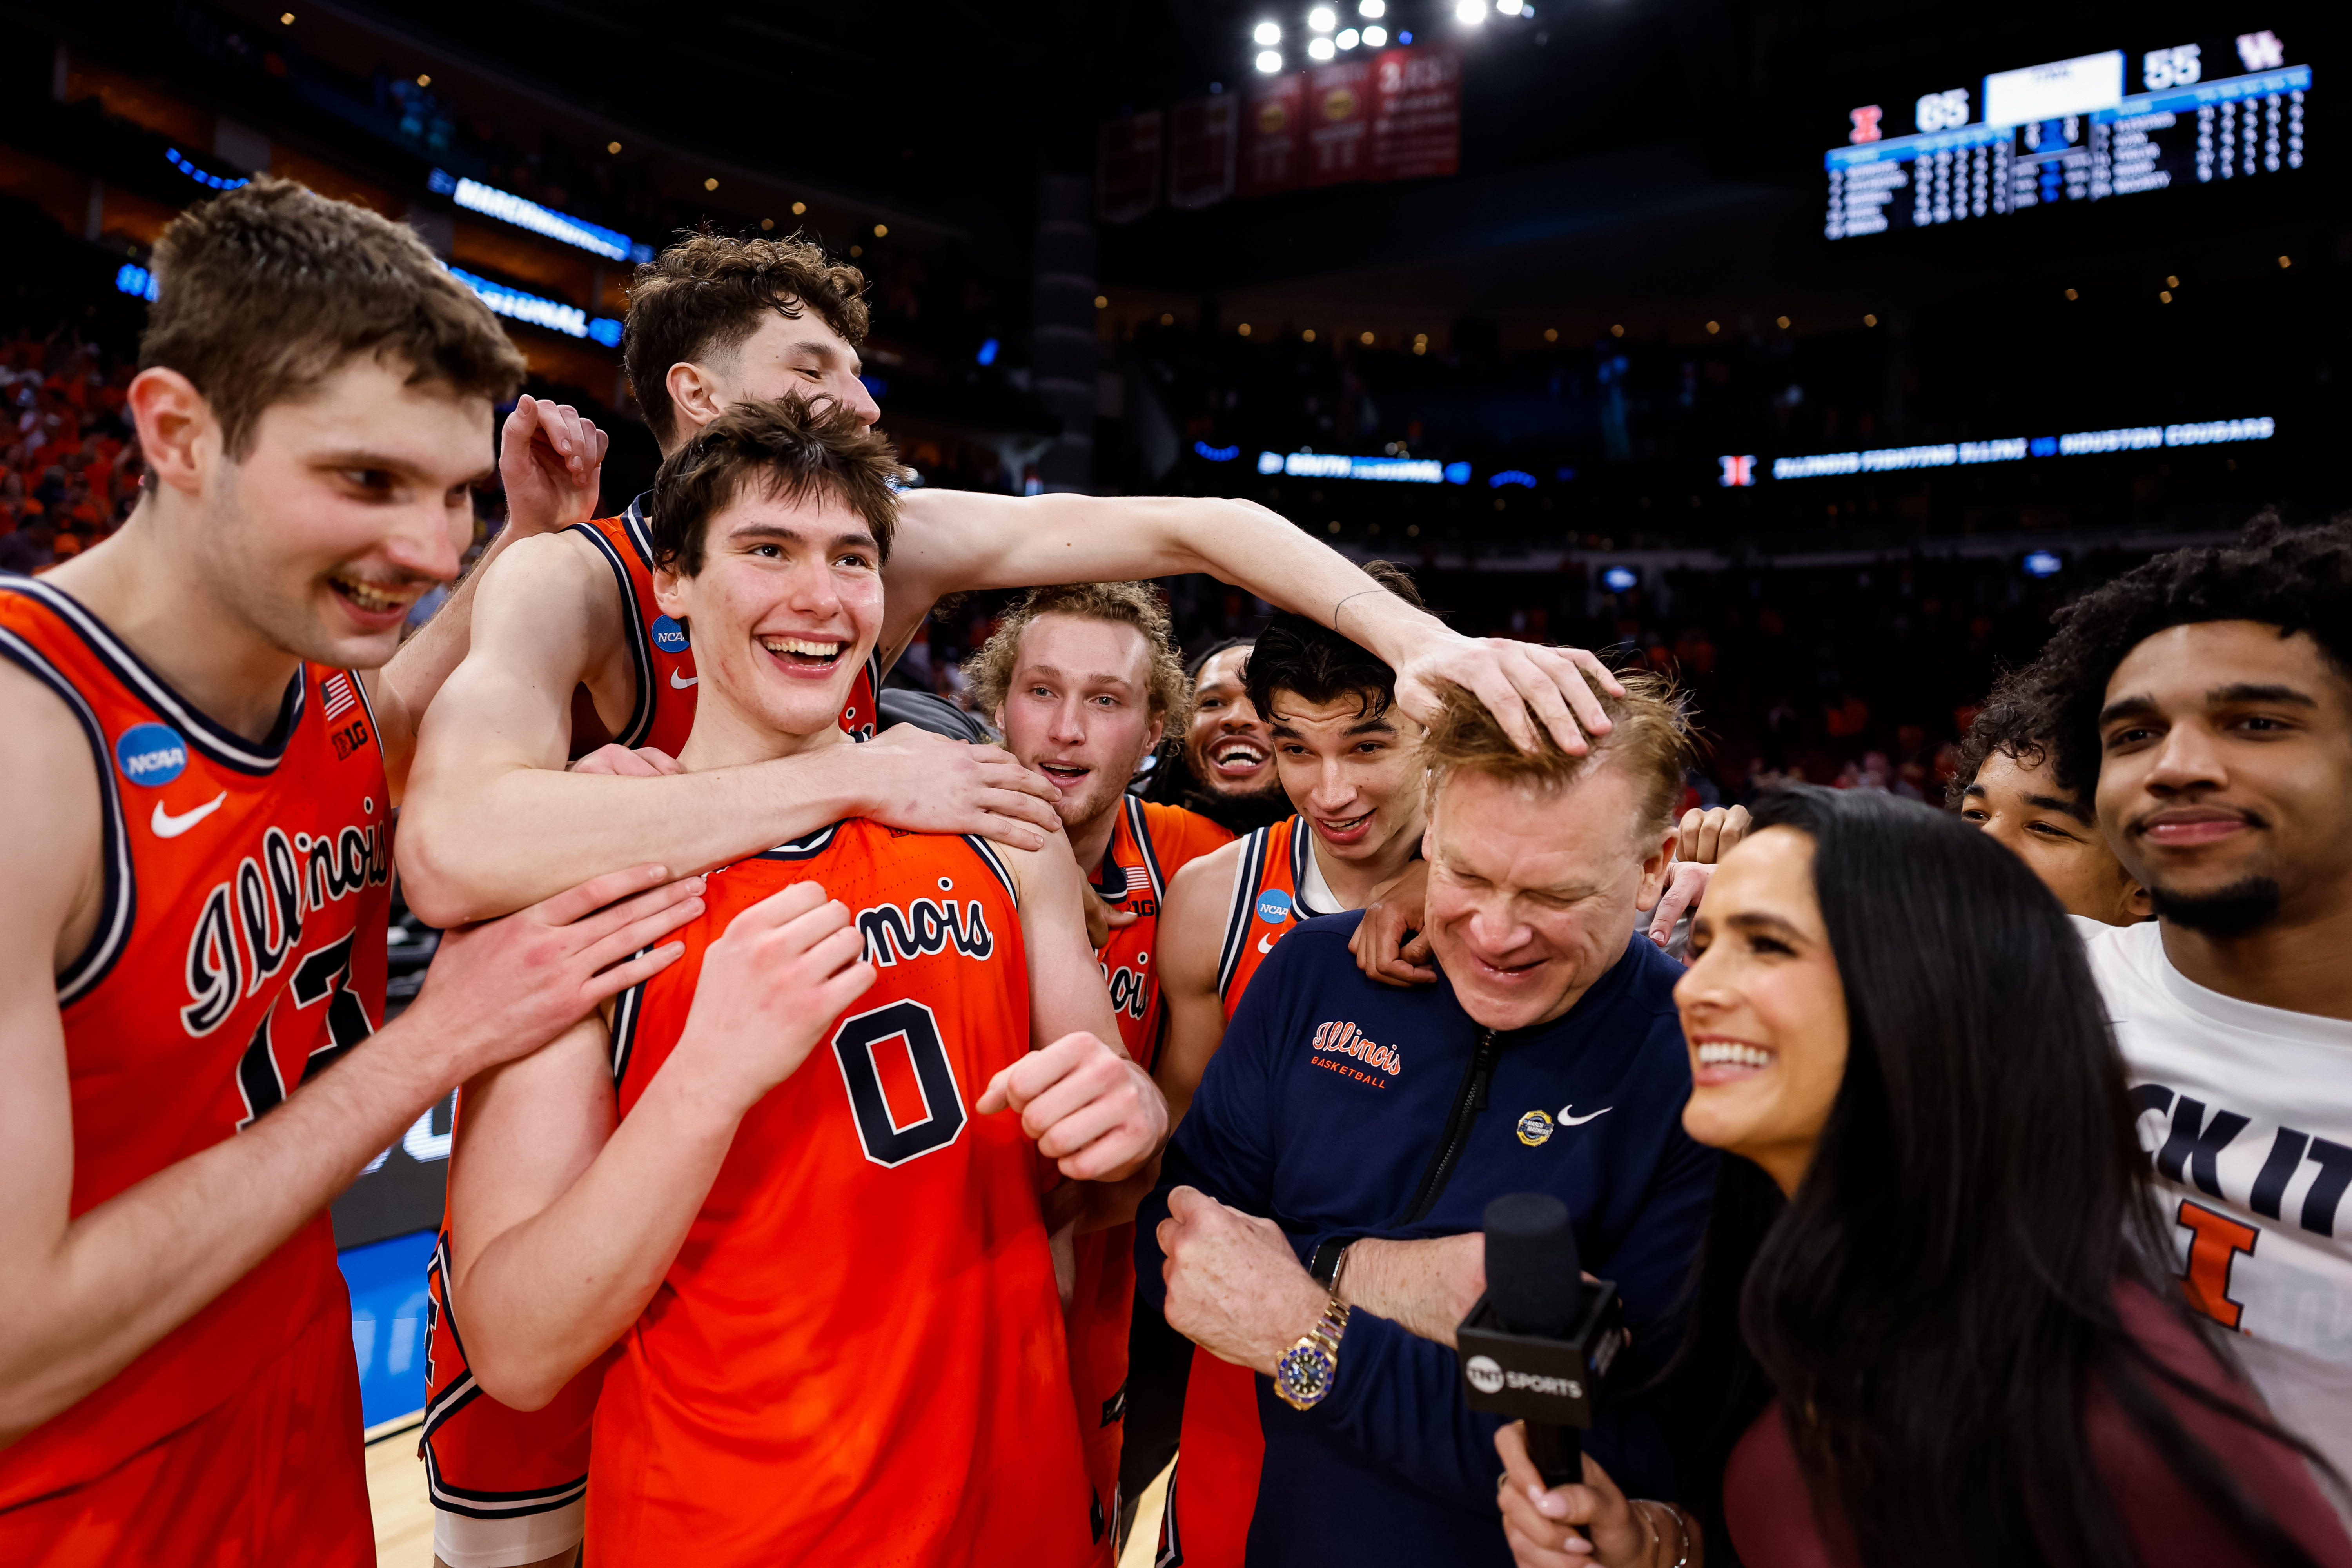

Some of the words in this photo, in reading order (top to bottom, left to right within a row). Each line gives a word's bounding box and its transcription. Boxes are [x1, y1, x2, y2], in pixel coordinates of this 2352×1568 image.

[2143, 43, 2201, 91] 55
[1915, 87, 1970, 134] 65
[658, 632, 685, 643] NCA
[127, 747, 185, 775] NCAA
[180, 796, 387, 1038] Illinois
[855, 877, 995, 967] nois
[1260, 903, 1289, 916] NCAA
[1312, 1021, 1401, 1075] Illinois
[831, 998, 968, 1169] 0
[1311, 1056, 1385, 1089] BASKETBALL
[1526, 1126, 1550, 1136] MADNESS
[1527, 1120, 1544, 1129] MARCH
[1505, 1370, 1583, 1399] SPORTS
